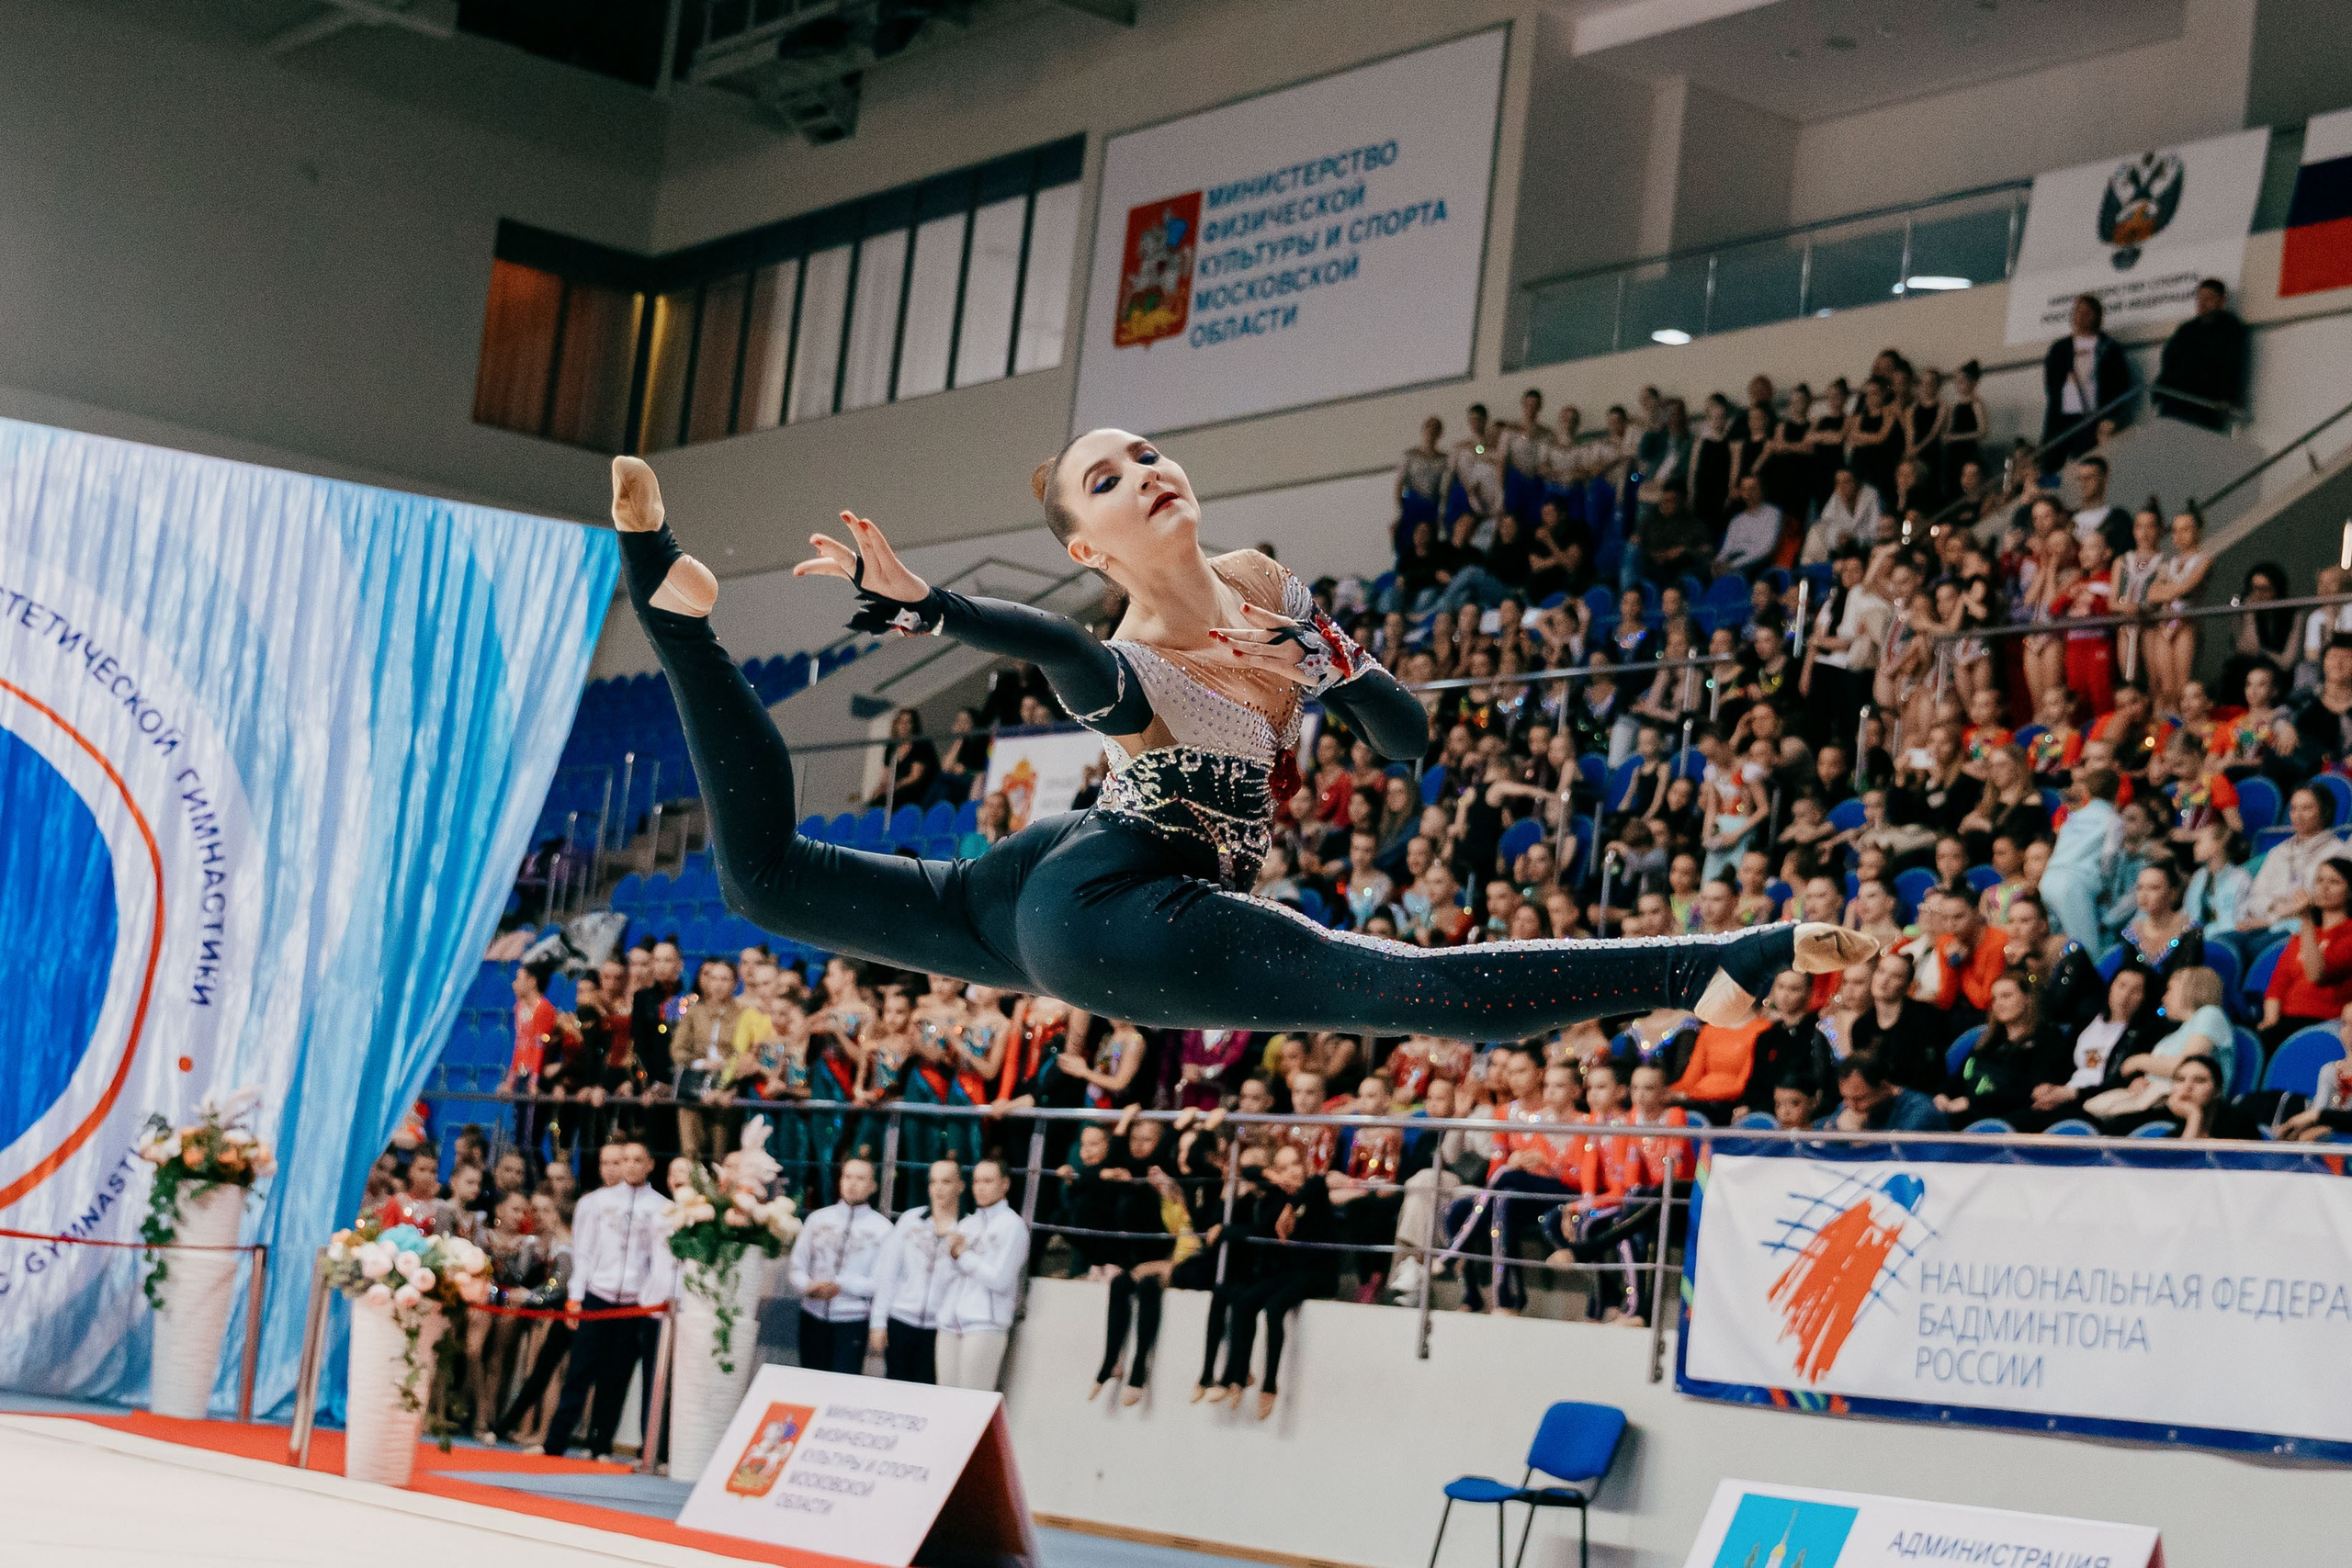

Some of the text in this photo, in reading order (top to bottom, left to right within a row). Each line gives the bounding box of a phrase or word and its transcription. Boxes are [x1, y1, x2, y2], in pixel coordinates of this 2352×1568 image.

[1206, 140, 1399, 211] МИНИСТЕРСТВО
[1198, 197, 1449, 278] КУЛЬТУРЫ И СПОРТА
[1204, 182, 1367, 244] ФИЗИЧЕСКОЙ
[1194, 252, 1361, 313] МОСКОВСКОЙ
[1189, 304, 1299, 349] ОБЛАСТИ
[0, 586, 227, 1008] ТЕТИЧЕСКОЙ ГИМНАСТИКИ
[1920, 1260, 2352, 1323] НАЦИОНАЛЬНАЯ ФЕДЕРА
[1918, 1302, 2152, 1353] БАДМИНТОНА
[1914, 1344, 2046, 1389] РОССИИ
